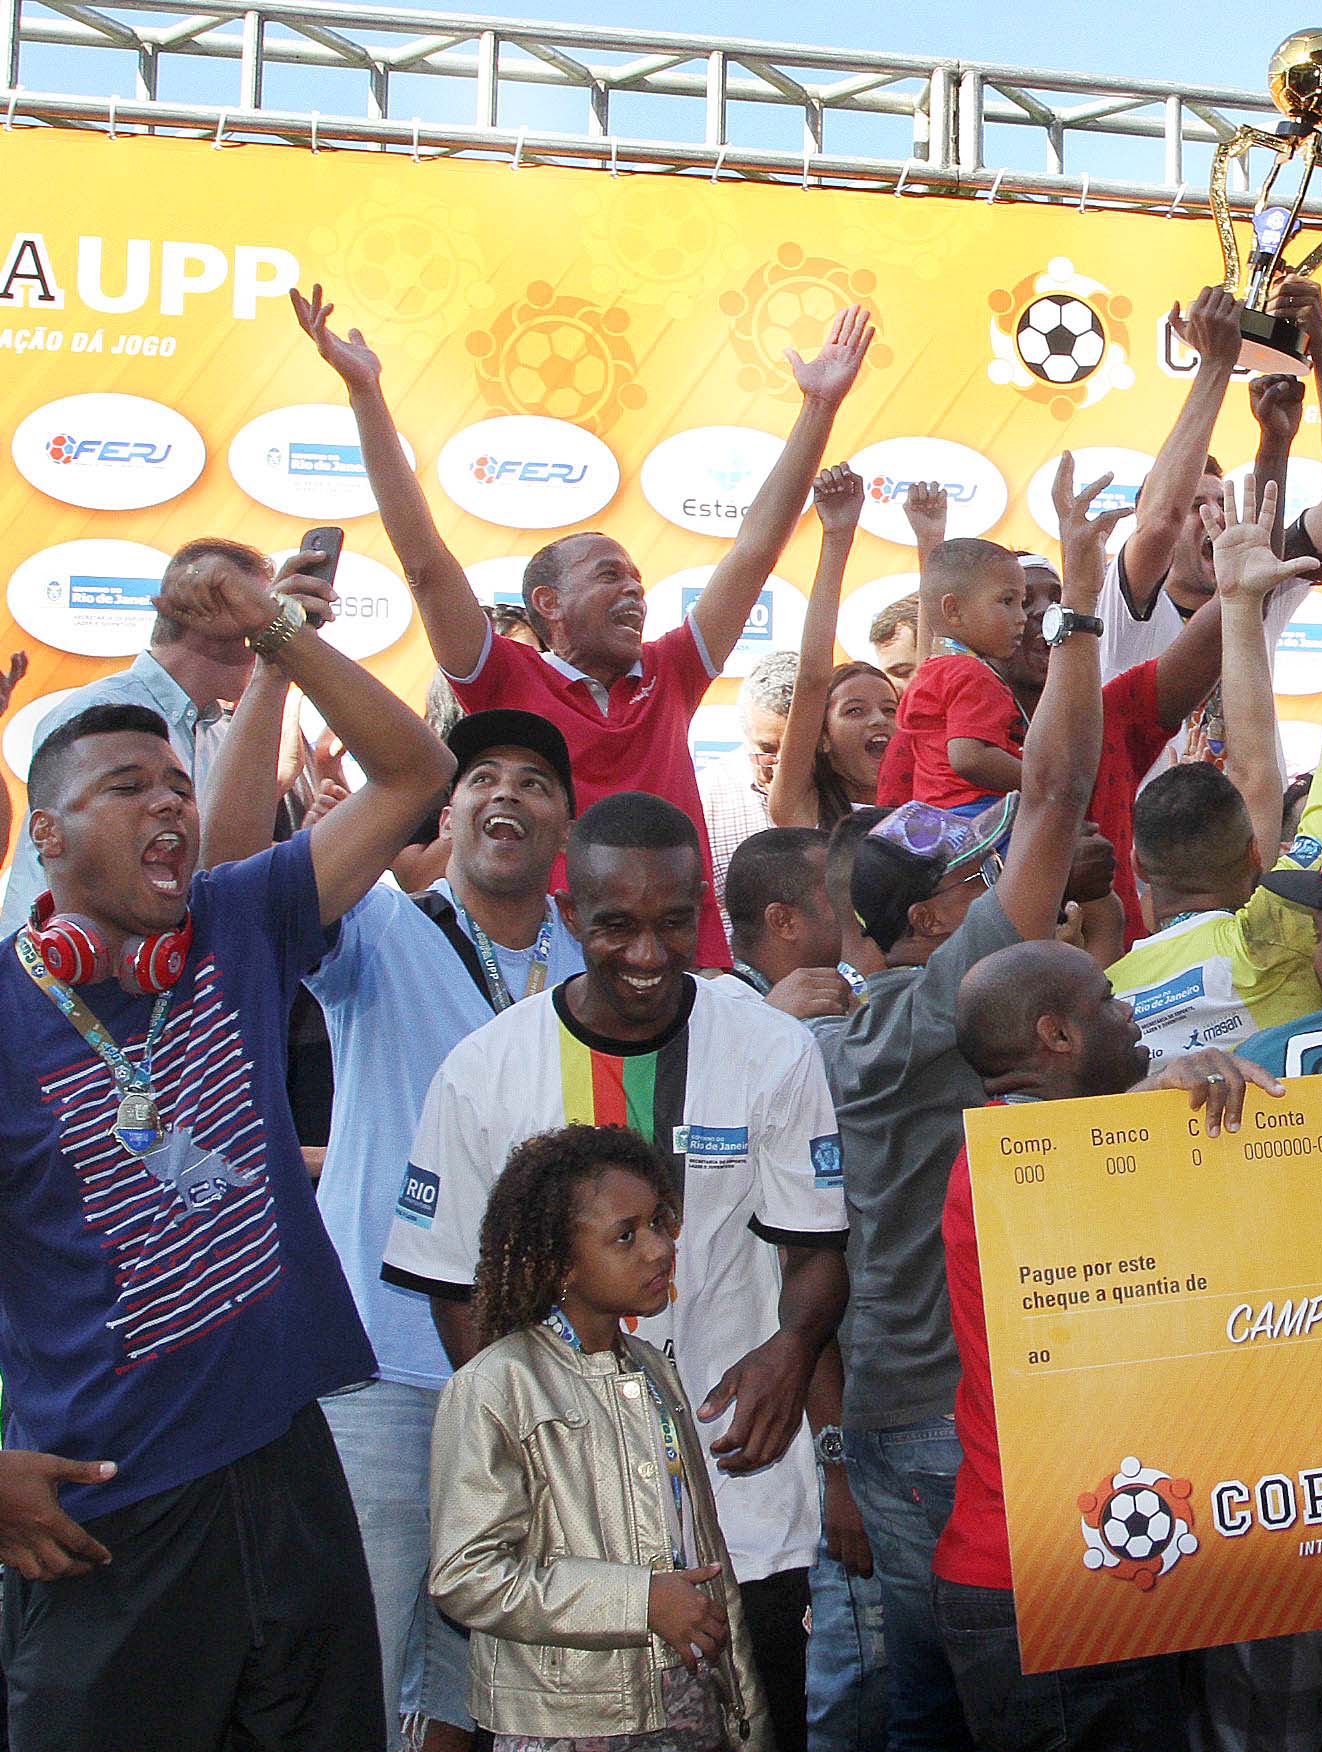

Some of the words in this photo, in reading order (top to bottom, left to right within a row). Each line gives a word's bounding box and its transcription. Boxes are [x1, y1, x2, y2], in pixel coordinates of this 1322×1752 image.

[71, 328, 104, 353] DÁ
[111, 334, 177, 358] JOGO
[72, 440, 172, 464] FERJ
[495, 460, 588, 484] FERJ
[332, 596, 389, 619] asan
[1134, 1004, 1150, 1015] Rio
[1151, 999, 1163, 1008] de
[1164, 985, 1200, 1004] Janeiro
[1203, 1015, 1243, 1041] masan
[690, 1142, 704, 1150] Rio
[705, 1143, 718, 1151] de
[1000, 1137, 1058, 1156] Comp.
[1091, 1127, 1150, 1147] Banco
[1188, 1118, 1200, 1137] C
[1255, 1111, 1305, 1130] Conta
[1014, 1164, 1045, 1185] 000
[1106, 1155, 1137, 1175] 000
[406, 1178, 436, 1203] RIO
[1018, 1264, 1077, 1286] Pague
[1083, 1262, 1113, 1282] por
[1118, 1255, 1157, 1275] este
[1022, 1287, 1090, 1311] cheque
[1096, 1286, 1107, 1302] a
[1112, 1276, 1180, 1305] quantia
[1185, 1273, 1208, 1293] de
[1028, 1349, 1051, 1364] ao
